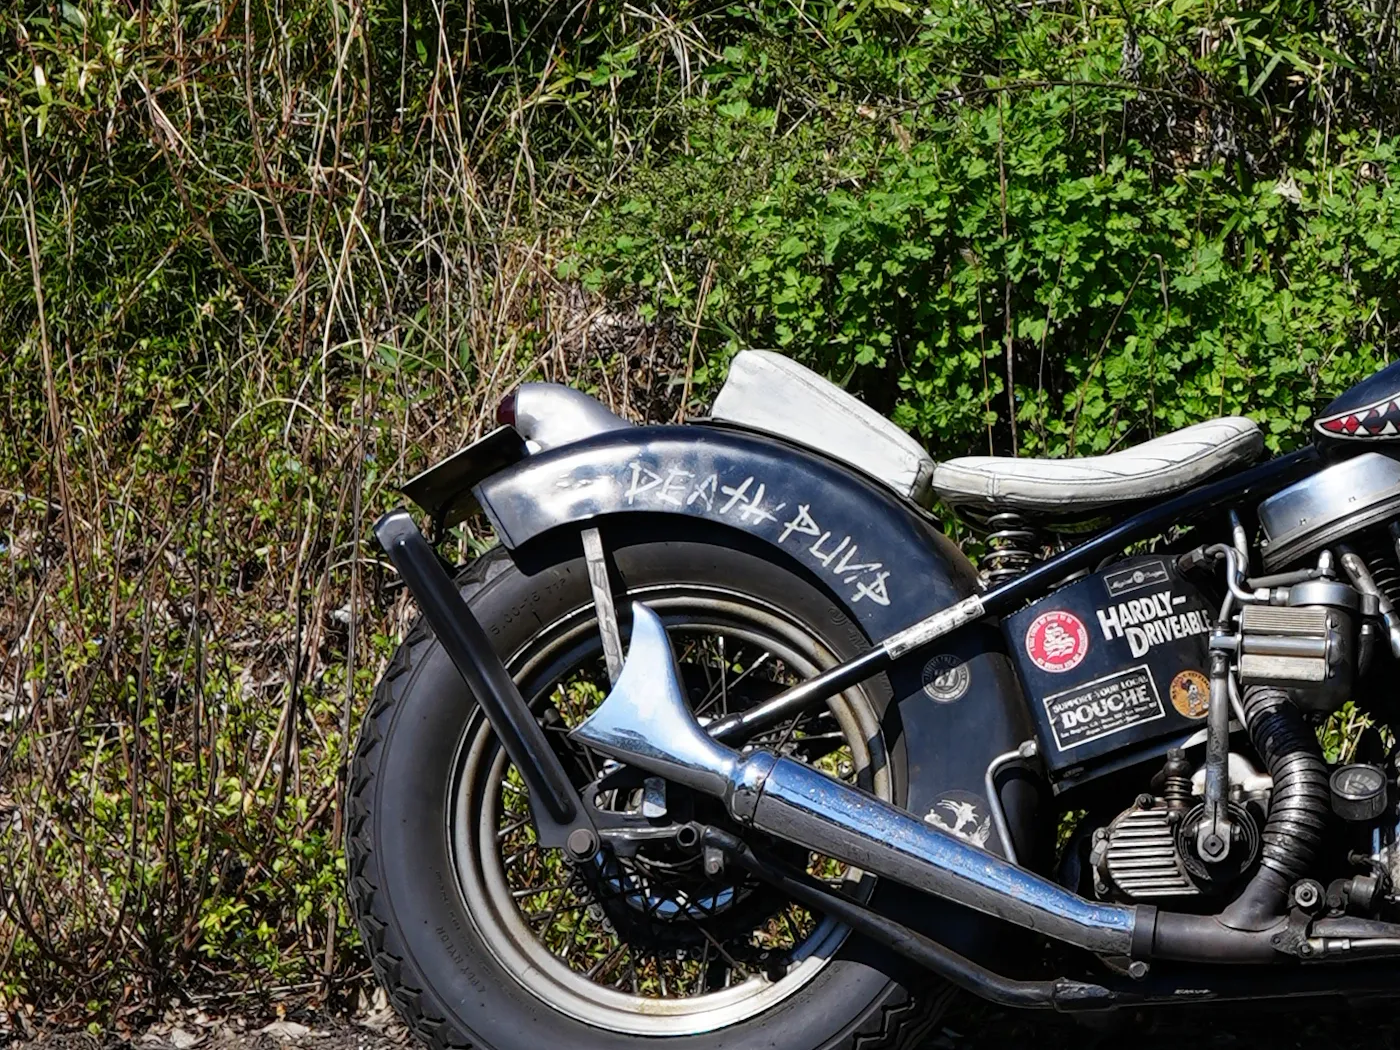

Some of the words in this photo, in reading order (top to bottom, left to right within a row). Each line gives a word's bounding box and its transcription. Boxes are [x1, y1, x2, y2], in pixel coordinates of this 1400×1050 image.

[1096, 591, 1186, 641] HARDLY-
[1124, 610, 1213, 658] DRIVEABLE
[1052, 692, 1093, 713] SUPPORT
[1060, 685, 1151, 729] DOUCHE
